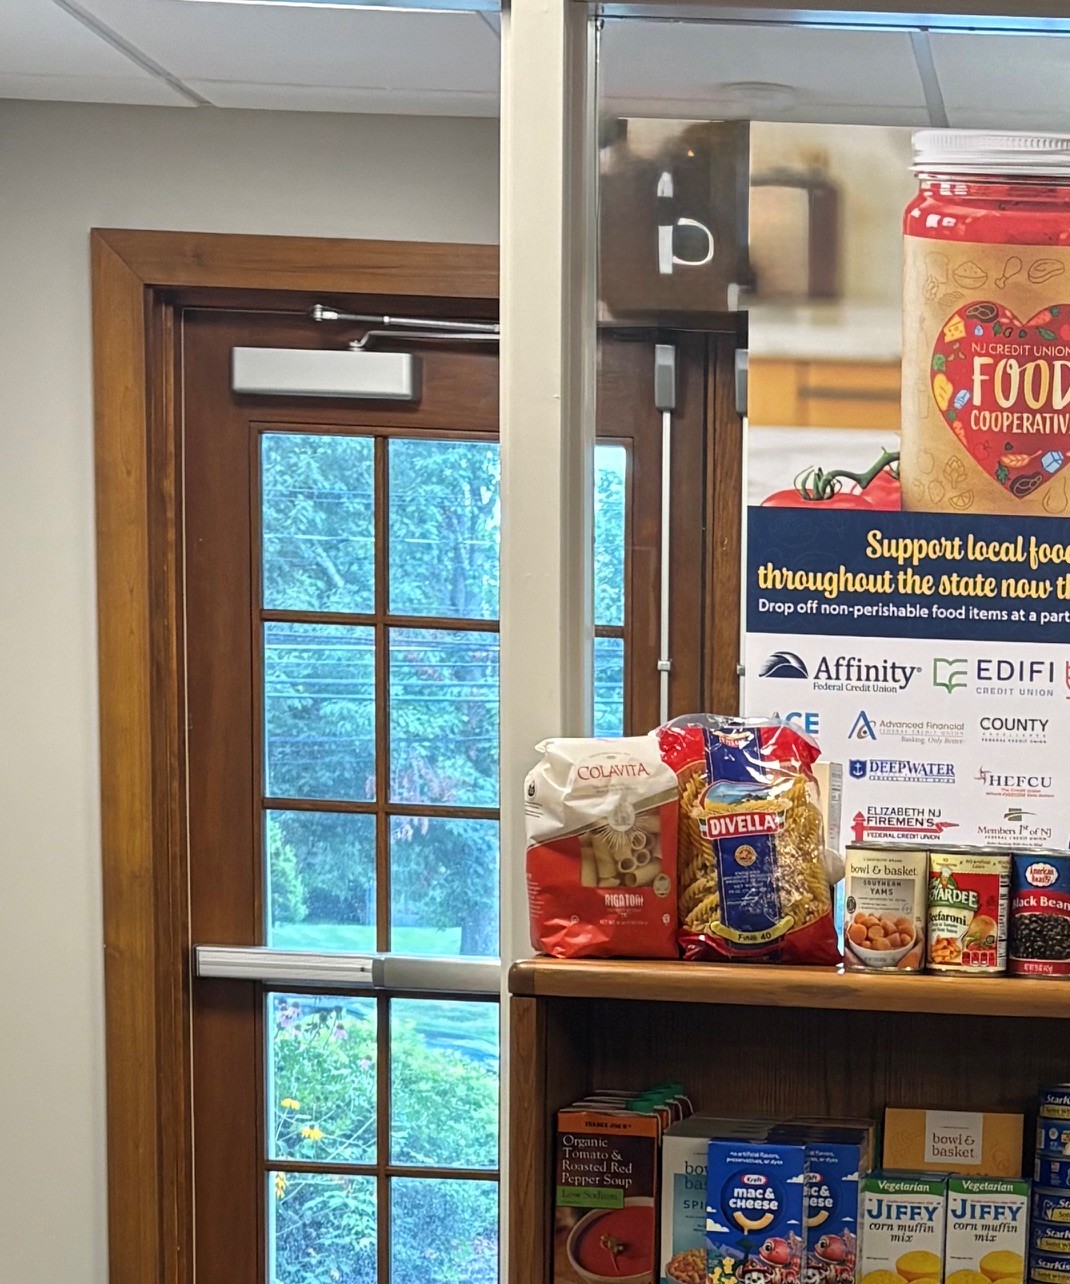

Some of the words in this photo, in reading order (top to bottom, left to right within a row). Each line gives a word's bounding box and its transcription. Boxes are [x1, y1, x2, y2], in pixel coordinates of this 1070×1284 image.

[971, 342, 986, 354] NJ
[989, 343, 1031, 356] CREDIT
[866, 529, 964, 566] Support
[967, 534, 1025, 563] local
[758, 562, 895, 599] throughout
[897, 568, 935, 595] the
[938, 572, 997, 597] state
[1001, 577, 1052, 600] now
[758, 599, 794, 616] Drop
[797, 600, 818, 615] off
[821, 602, 929, 619] non-perishable
[932, 605, 965, 619] food
[969, 607, 1008, 621] items
[1011, 610, 1025, 622] at
[1029, 611, 1037, 622] a
[813, 656, 915, 690] Affinity
[976, 659, 1055, 683] EDIFI
[813, 683, 844, 692] Federal
[846, 684, 870, 693] Credit
[872, 684, 897, 694] Union
[976, 687, 1014, 695] CREDIT
[1019, 688, 1055, 697] UNION
[980, 717, 1049, 732] COUNTY
[578, 763, 650, 781] COLAVITA
[870, 760, 955, 778] DEEPWATER
[989, 774, 1052, 788] HEFCU
[867, 806, 925, 817] ELIZABETH
[927, 808, 942, 817] NJ
[710, 813, 775, 834] DIVELLA
[866, 816, 935, 827] FIREMEN'S
[977, 824, 1016, 836] Members
[563, 1135, 608, 1149] Organic
[563, 1148, 609, 1160] Tomato
[611, 1150, 623, 1161] &
[932, 1145, 975, 1158] basket
[562, 1161, 607, 1172] Roasted
[611, 1163, 632, 1174] Red
[562, 1173, 597, 1186] Pepper
[600, 1175, 633, 1188] Soup
[878, 1180, 930, 1192] Vegetarian
[962, 1180, 1014, 1192] Vegetarian
[867, 1199, 938, 1222] JIFFY
[951, 1199, 1022, 1222] JIFFY
[869, 1222, 895, 1232] corn
[897, 1220, 935, 1234] muffin
[890, 1233, 913, 1243] mix
